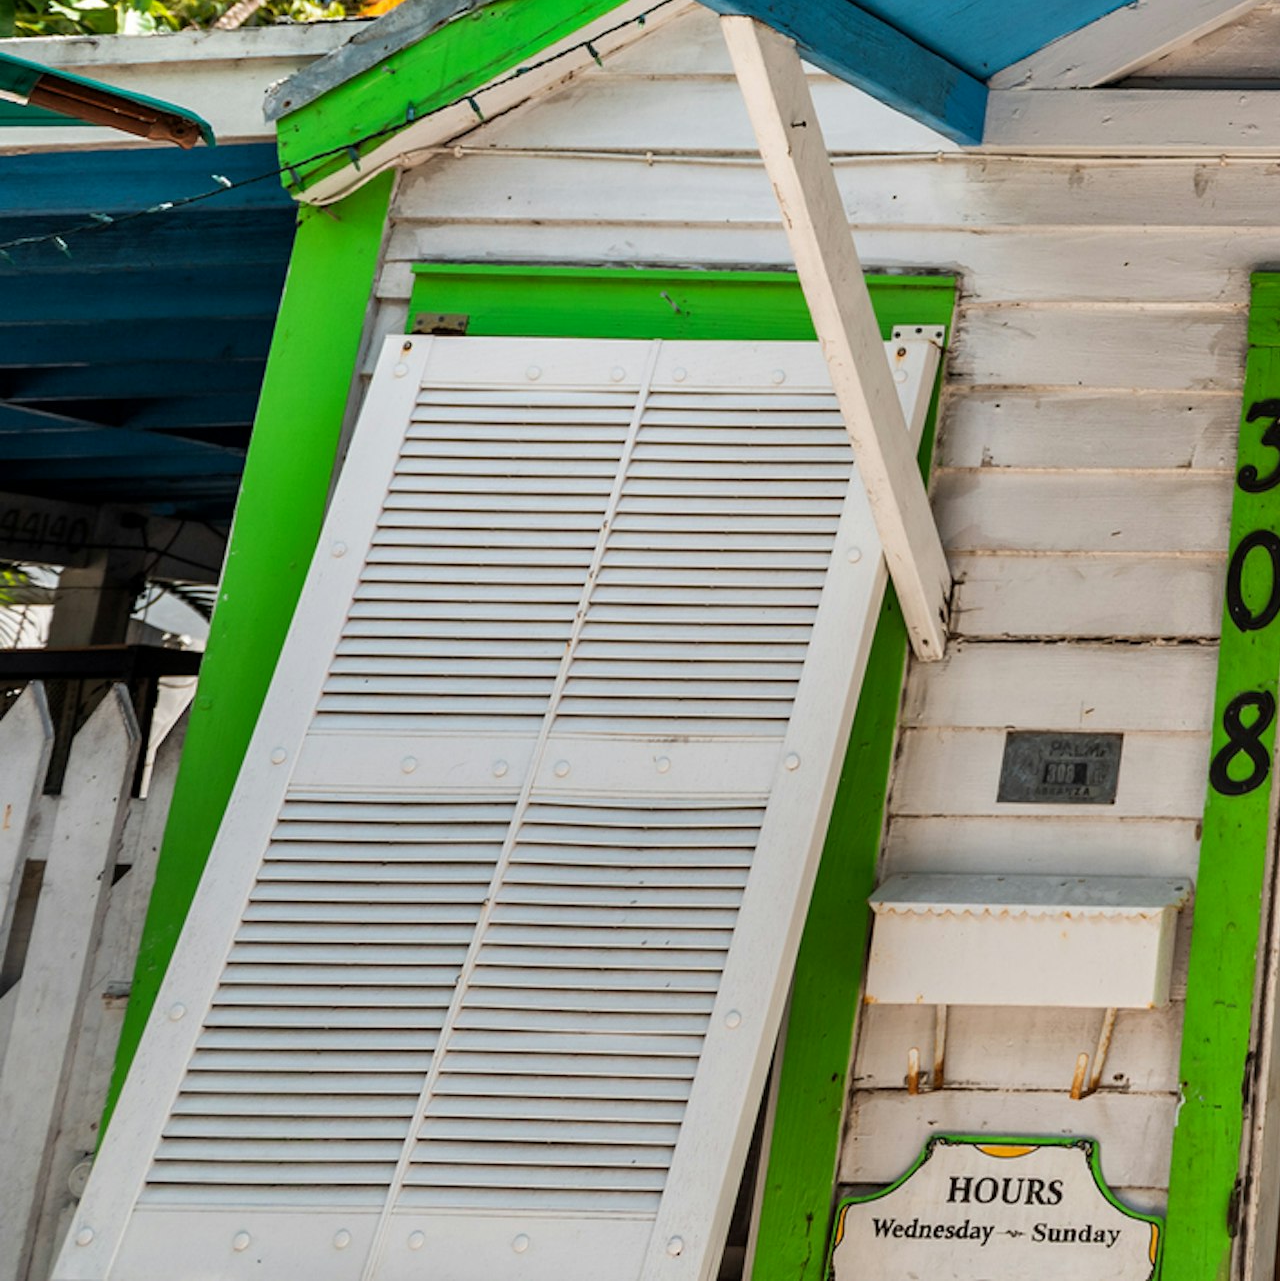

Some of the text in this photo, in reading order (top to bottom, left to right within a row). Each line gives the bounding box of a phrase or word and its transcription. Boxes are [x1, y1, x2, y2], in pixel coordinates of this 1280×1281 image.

[1046, 763, 1075, 784] 308
[946, 1176, 1064, 1206] HOURS
[871, 1218, 1122, 1249] Wednesday Sunday
